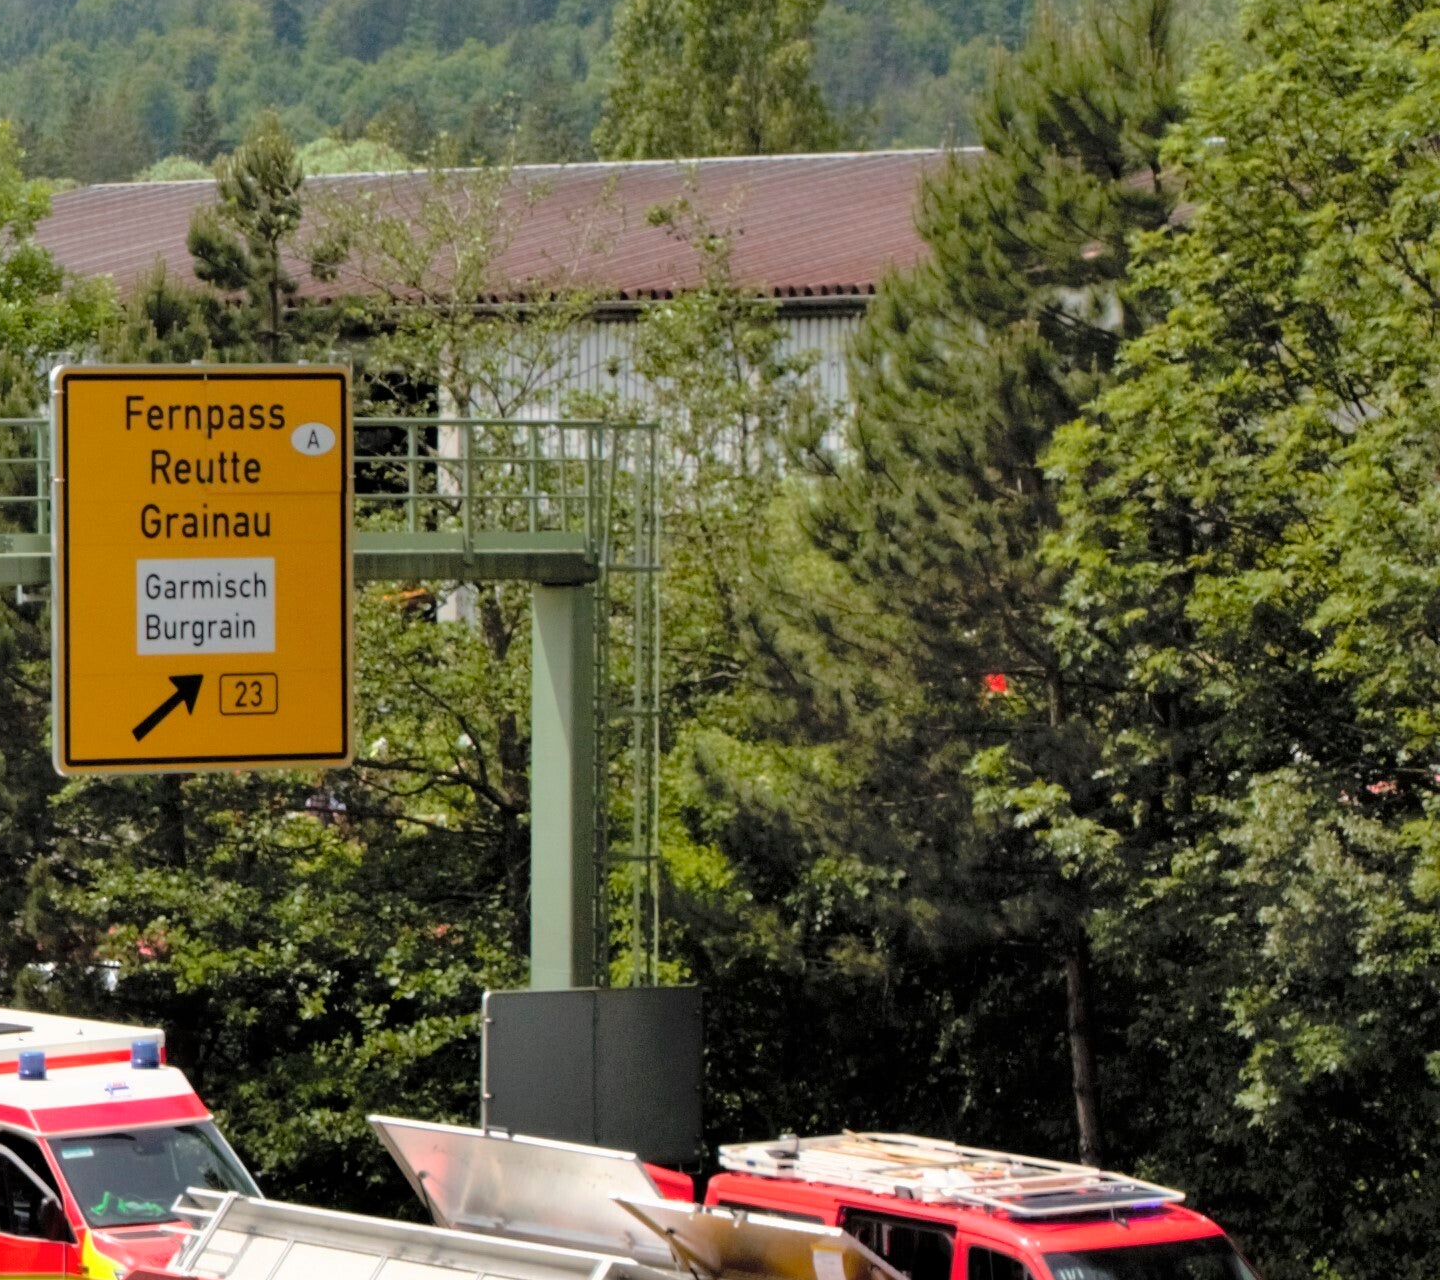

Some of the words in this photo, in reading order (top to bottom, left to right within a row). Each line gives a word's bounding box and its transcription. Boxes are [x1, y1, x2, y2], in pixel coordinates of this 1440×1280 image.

[125, 395, 286, 439] Fernpass
[306, 429, 321, 449] A
[150, 449, 262, 484] Reutte
[140, 502, 271, 539] Grainau
[145, 572, 267, 600] Garmisch
[145, 612, 256, 647] Burgrain
[234, 680, 263, 708] 23
